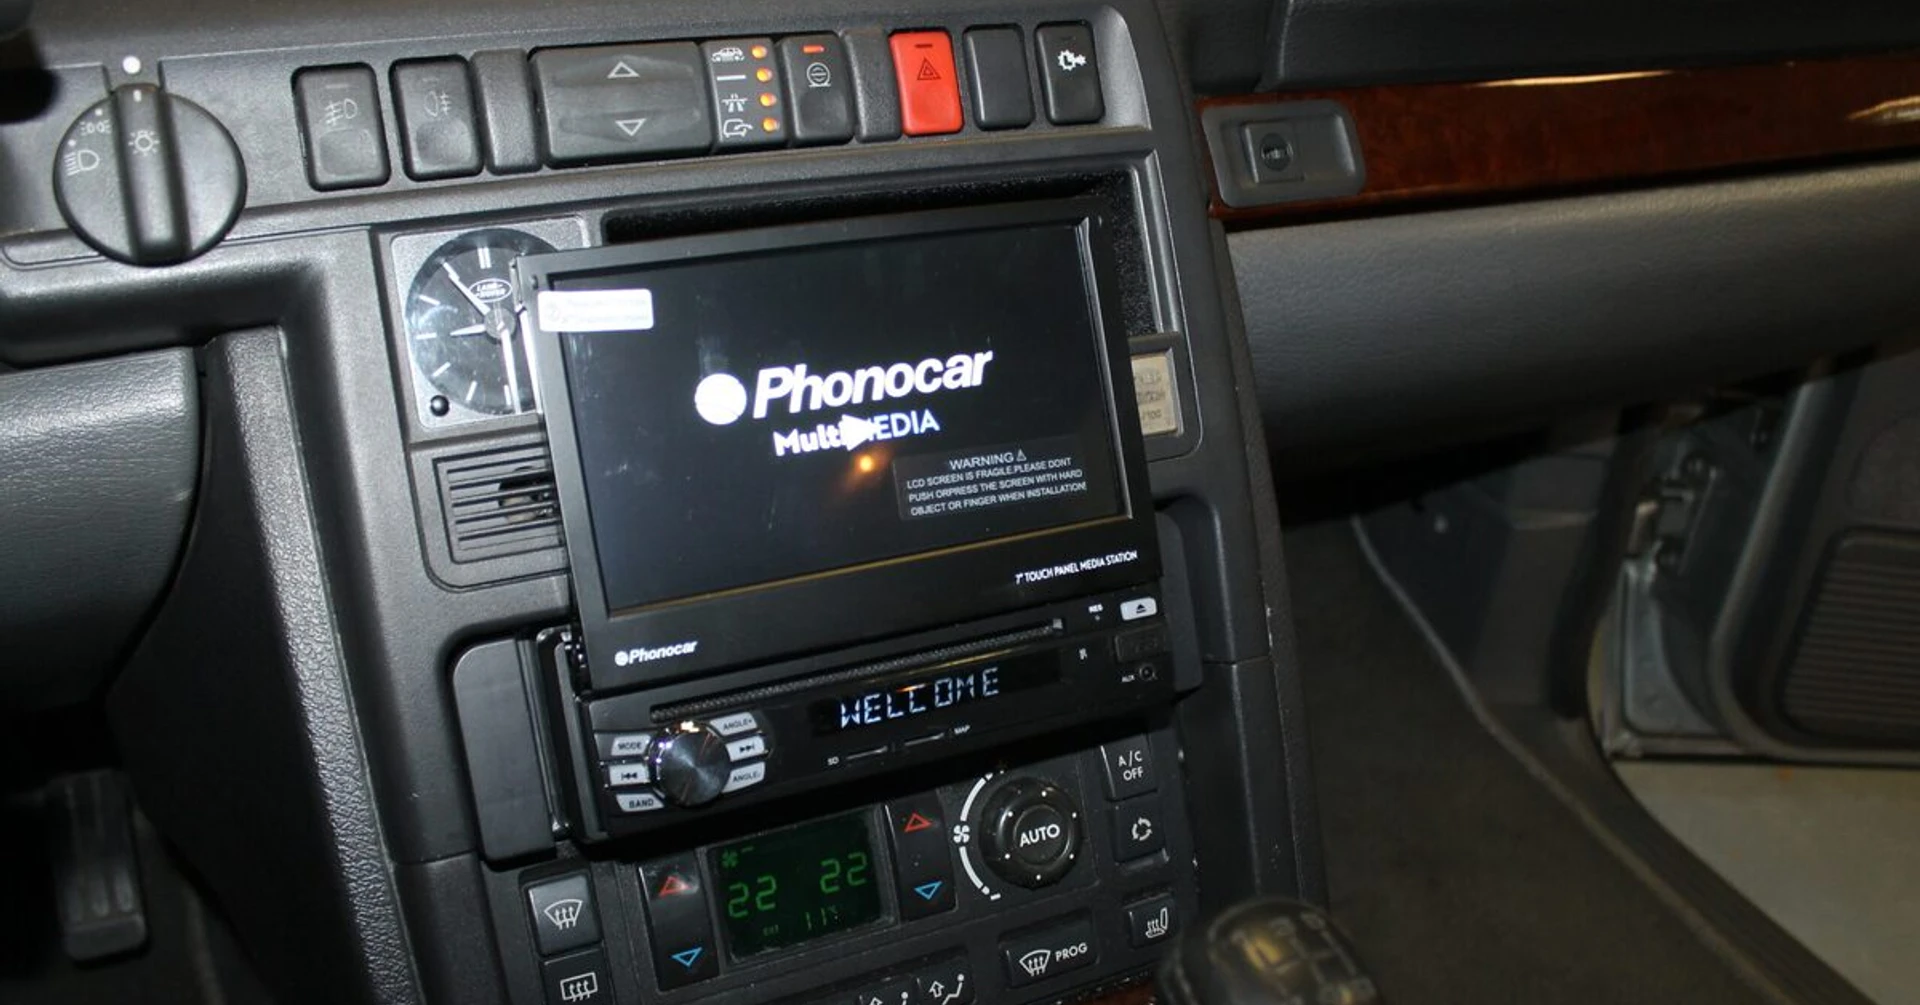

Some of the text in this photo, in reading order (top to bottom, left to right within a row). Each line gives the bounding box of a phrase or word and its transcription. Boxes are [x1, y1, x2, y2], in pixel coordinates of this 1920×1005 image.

[753, 351, 993, 419] Phonocar
[907, 478, 926, 490] LCD
[926, 472, 964, 487] SCREEN
[964, 471, 975, 481] IS
[1048, 457, 1072, 469] DONT
[949, 452, 1014, 470] WARNING
[908, 491, 935, 503] PUSH
[979, 480, 998, 492] THE
[998, 476, 1035, 490] SCREEN
[1035, 471, 1058, 483] WITH
[1058, 468, 1083, 481] HARD
[910, 502, 947, 516] OBJECT
[947, 500, 963, 510] OR
[963, 494, 998, 508] FINGER
[997, 490, 1026, 503] WHEN
[1024, 567, 1054, 583] TOUCH
[1053, 562, 1080, 576] PANEL
[1079, 558, 1106, 571] MEDIA
[1105, 550, 1138, 566] STATION
[628, 640, 699, 665] Phonocar
[840, 668, 999, 728] WELCOME
[617, 741, 642, 750] MODE
[1118, 749, 1144, 768] A/C
[1123, 766, 1144, 781] OFF
[628, 797, 654, 810] BAND
[1019, 823, 1060, 848] AUTO
[728, 852, 868, 918] 22 22
[1055, 942, 1088, 963] PROG
